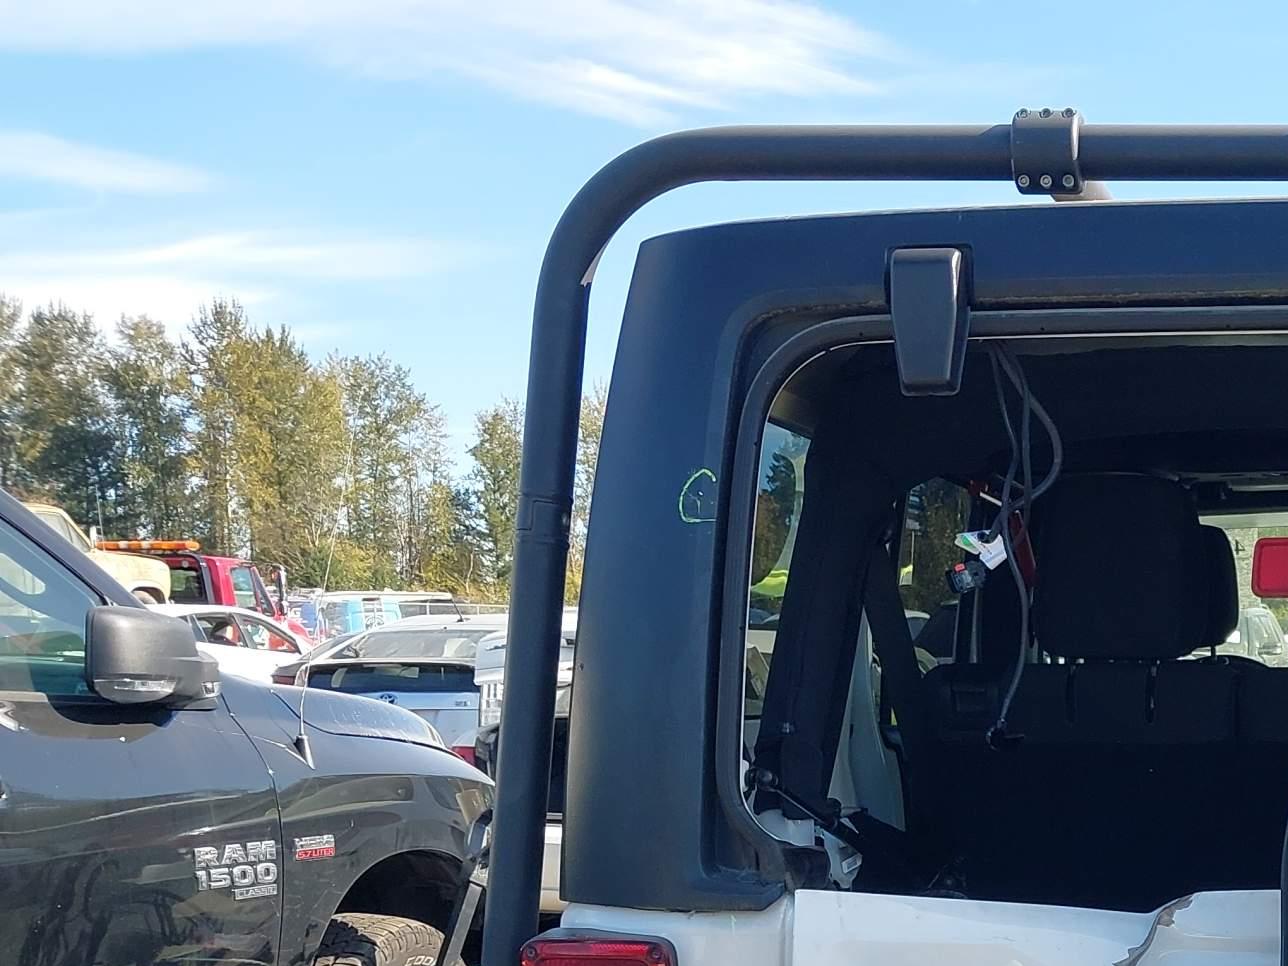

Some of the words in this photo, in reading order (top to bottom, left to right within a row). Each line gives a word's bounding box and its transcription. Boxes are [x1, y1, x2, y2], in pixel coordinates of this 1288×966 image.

[193, 840, 277, 869] RAM
[195, 862, 278, 892] 1500
[236, 885, 277, 899] CLASSIC
